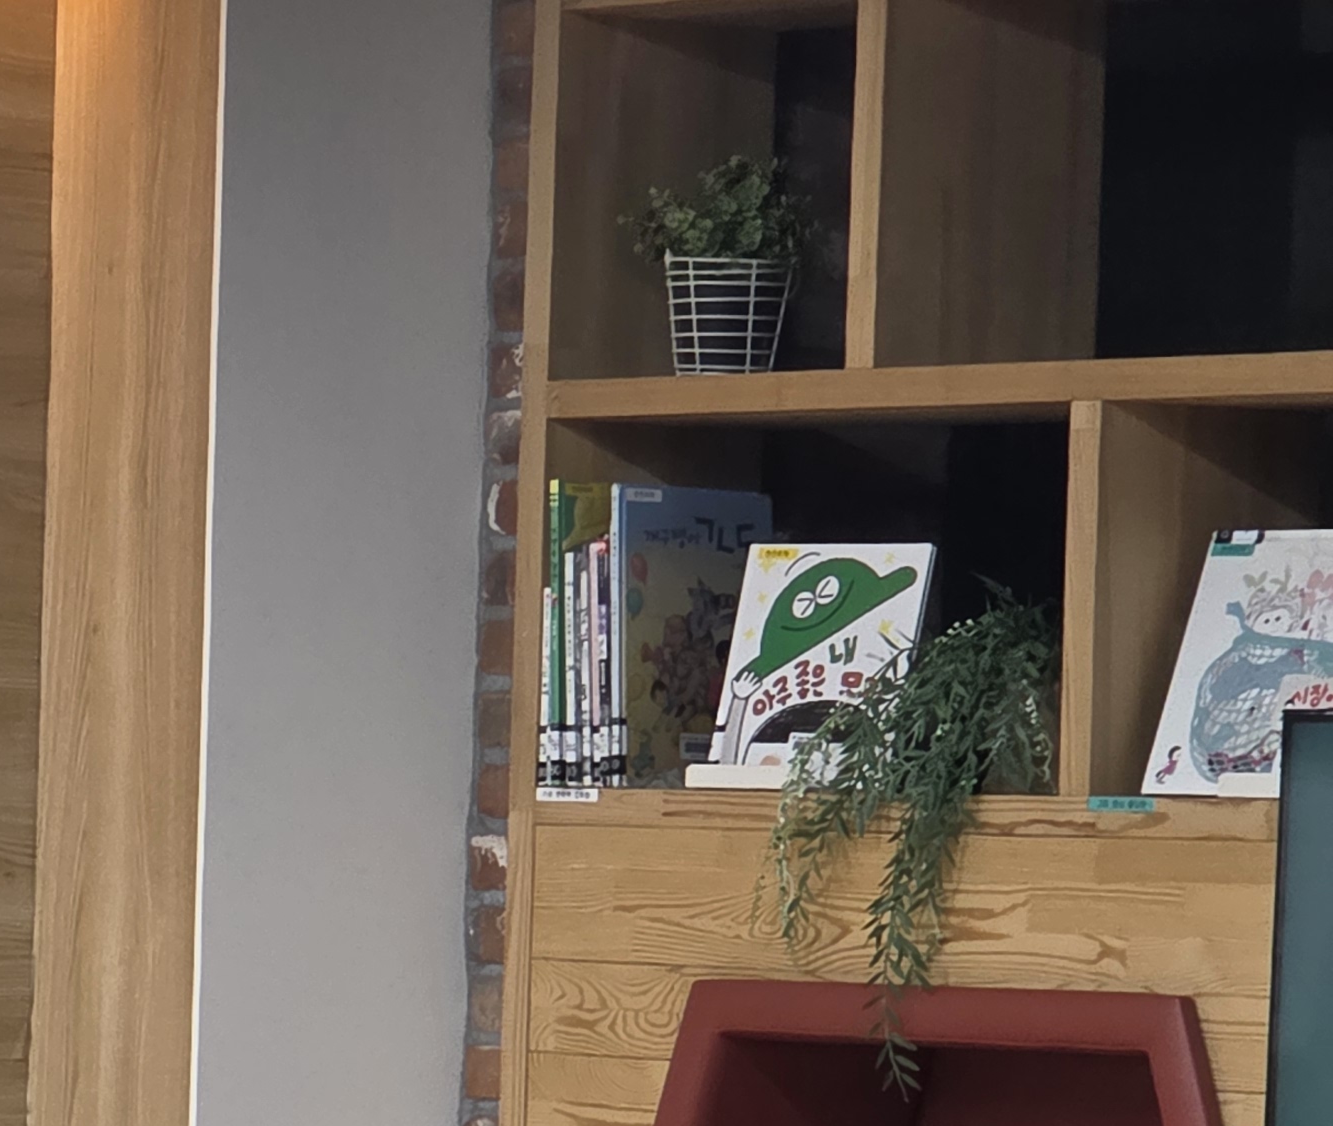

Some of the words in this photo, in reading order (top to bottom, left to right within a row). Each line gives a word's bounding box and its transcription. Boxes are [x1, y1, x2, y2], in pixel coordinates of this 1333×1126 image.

[752, 675, 793, 716] 아주
[794, 659, 826, 699] 좋은
[829, 635, 858, 665] 내
